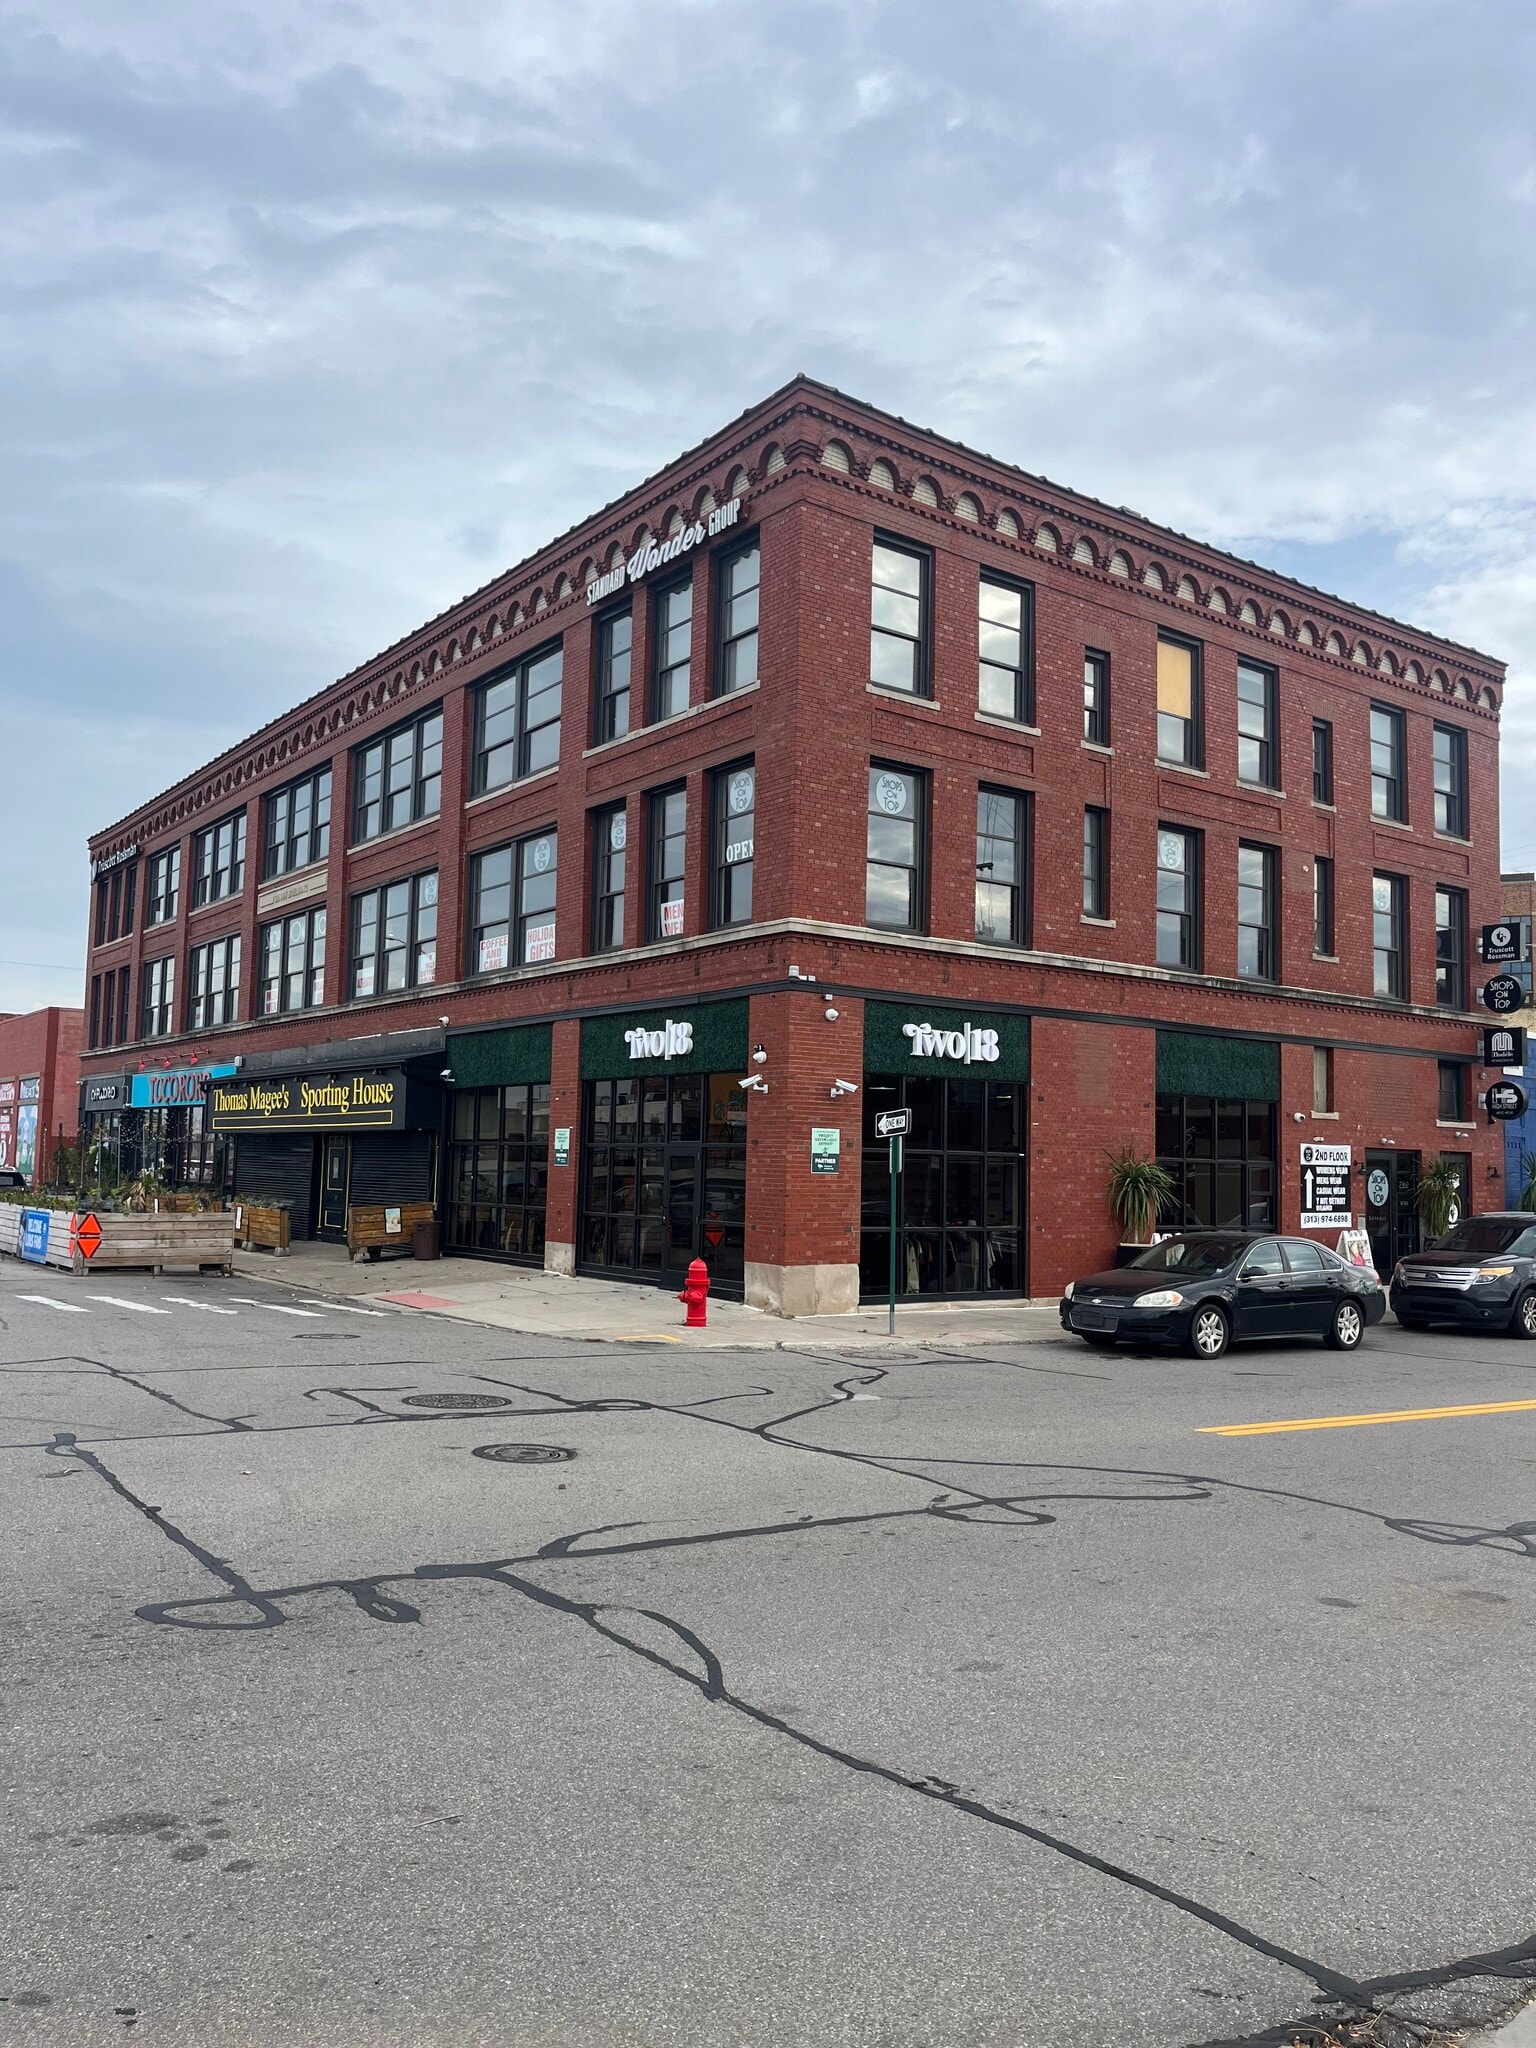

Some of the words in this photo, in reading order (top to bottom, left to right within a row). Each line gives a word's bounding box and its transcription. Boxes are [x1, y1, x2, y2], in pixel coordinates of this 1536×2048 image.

[586, 565, 625, 606] STANDARD
[626, 520, 706, 583] Wonder
[708, 498, 740, 536] GROUP
[881, 776, 903, 791] SHOPS
[883, 797, 900, 811] TOP
[481, 936, 508, 950] COFFEE
[486, 948, 502, 960] AND
[530, 942, 555, 960] GIFTS
[484, 958, 502, 970] CAKE
[1490, 980, 1514, 991] SHOPS
[1494, 999, 1510, 1009] TOP
[213, 1089, 248, 1112] Thomas
[250, 1084, 290, 1116] Magee's
[300, 1079, 350, 1114] Sporting
[352, 1077, 394, 1104] House
[886, 1119, 895, 1129] ONE
[896, 1117, 904, 1126] WAY
[1315, 1149, 1328, 1161] 2ND
[1330, 1151, 1348, 1162] FLOOR
[1371, 1173, 1386, 1184] SHOPS
[1373, 1192, 1384, 1204] TOP
[1304, 1215, 1319, 1224] (313)
[1321, 1215, 1348, 1223] 974-6898
